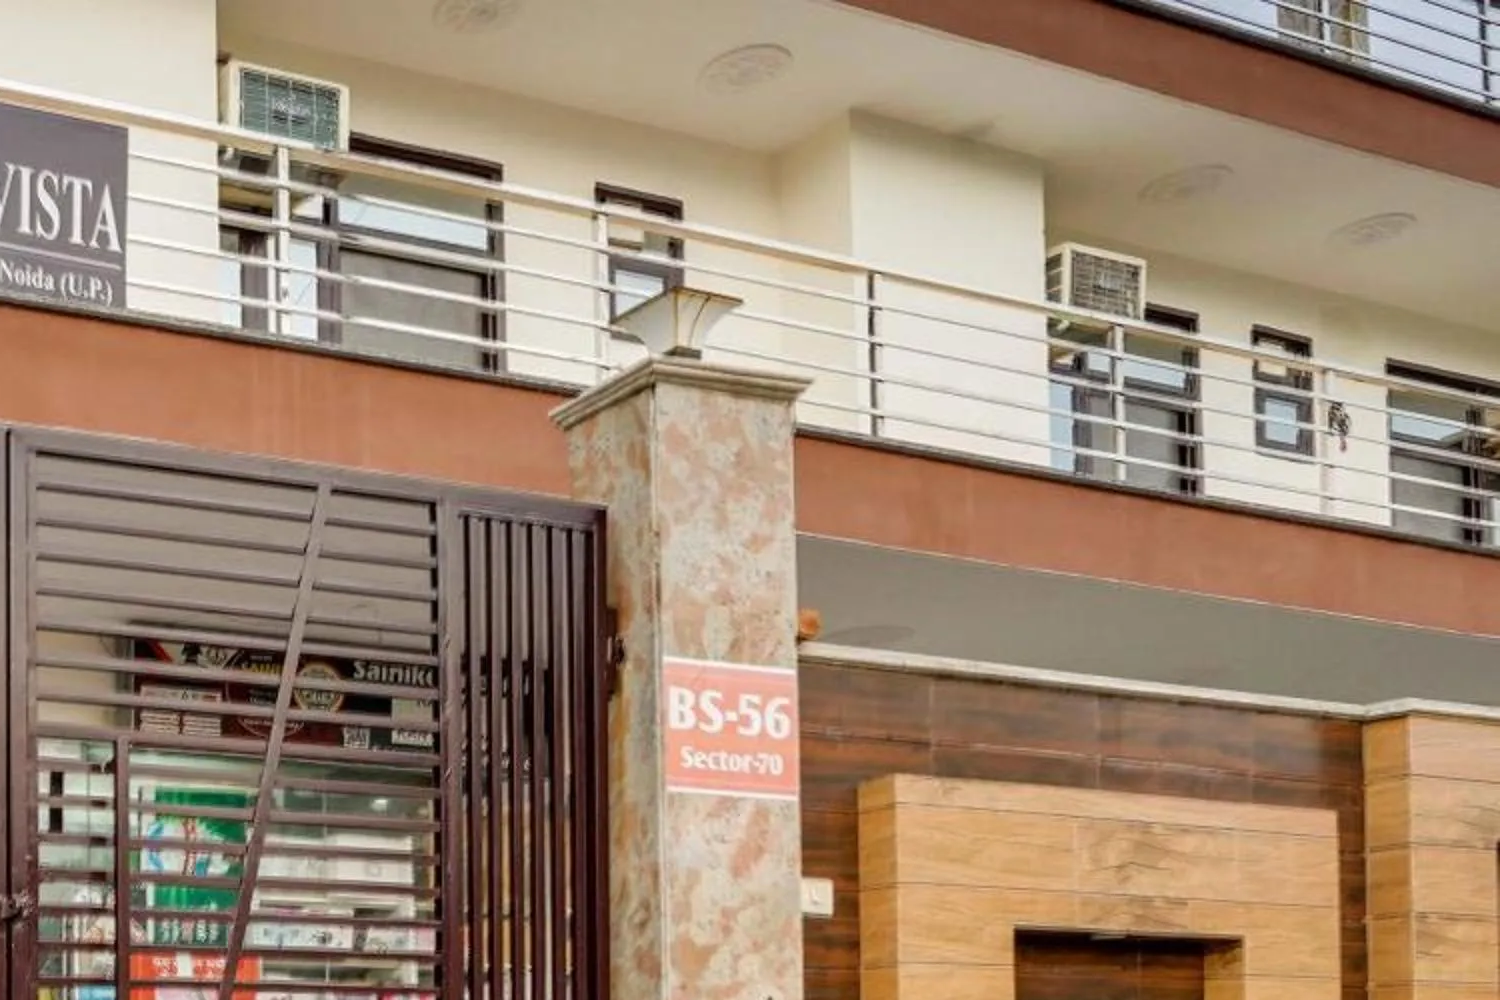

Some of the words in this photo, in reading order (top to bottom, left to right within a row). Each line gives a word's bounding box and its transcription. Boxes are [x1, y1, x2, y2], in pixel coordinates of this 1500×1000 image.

[0, 258, 54, 291] Noida
[60, 271, 113, 307] (U.P.)
[669, 685, 791, 740] BS-56
[680, 745, 784, 776] Sector-70
